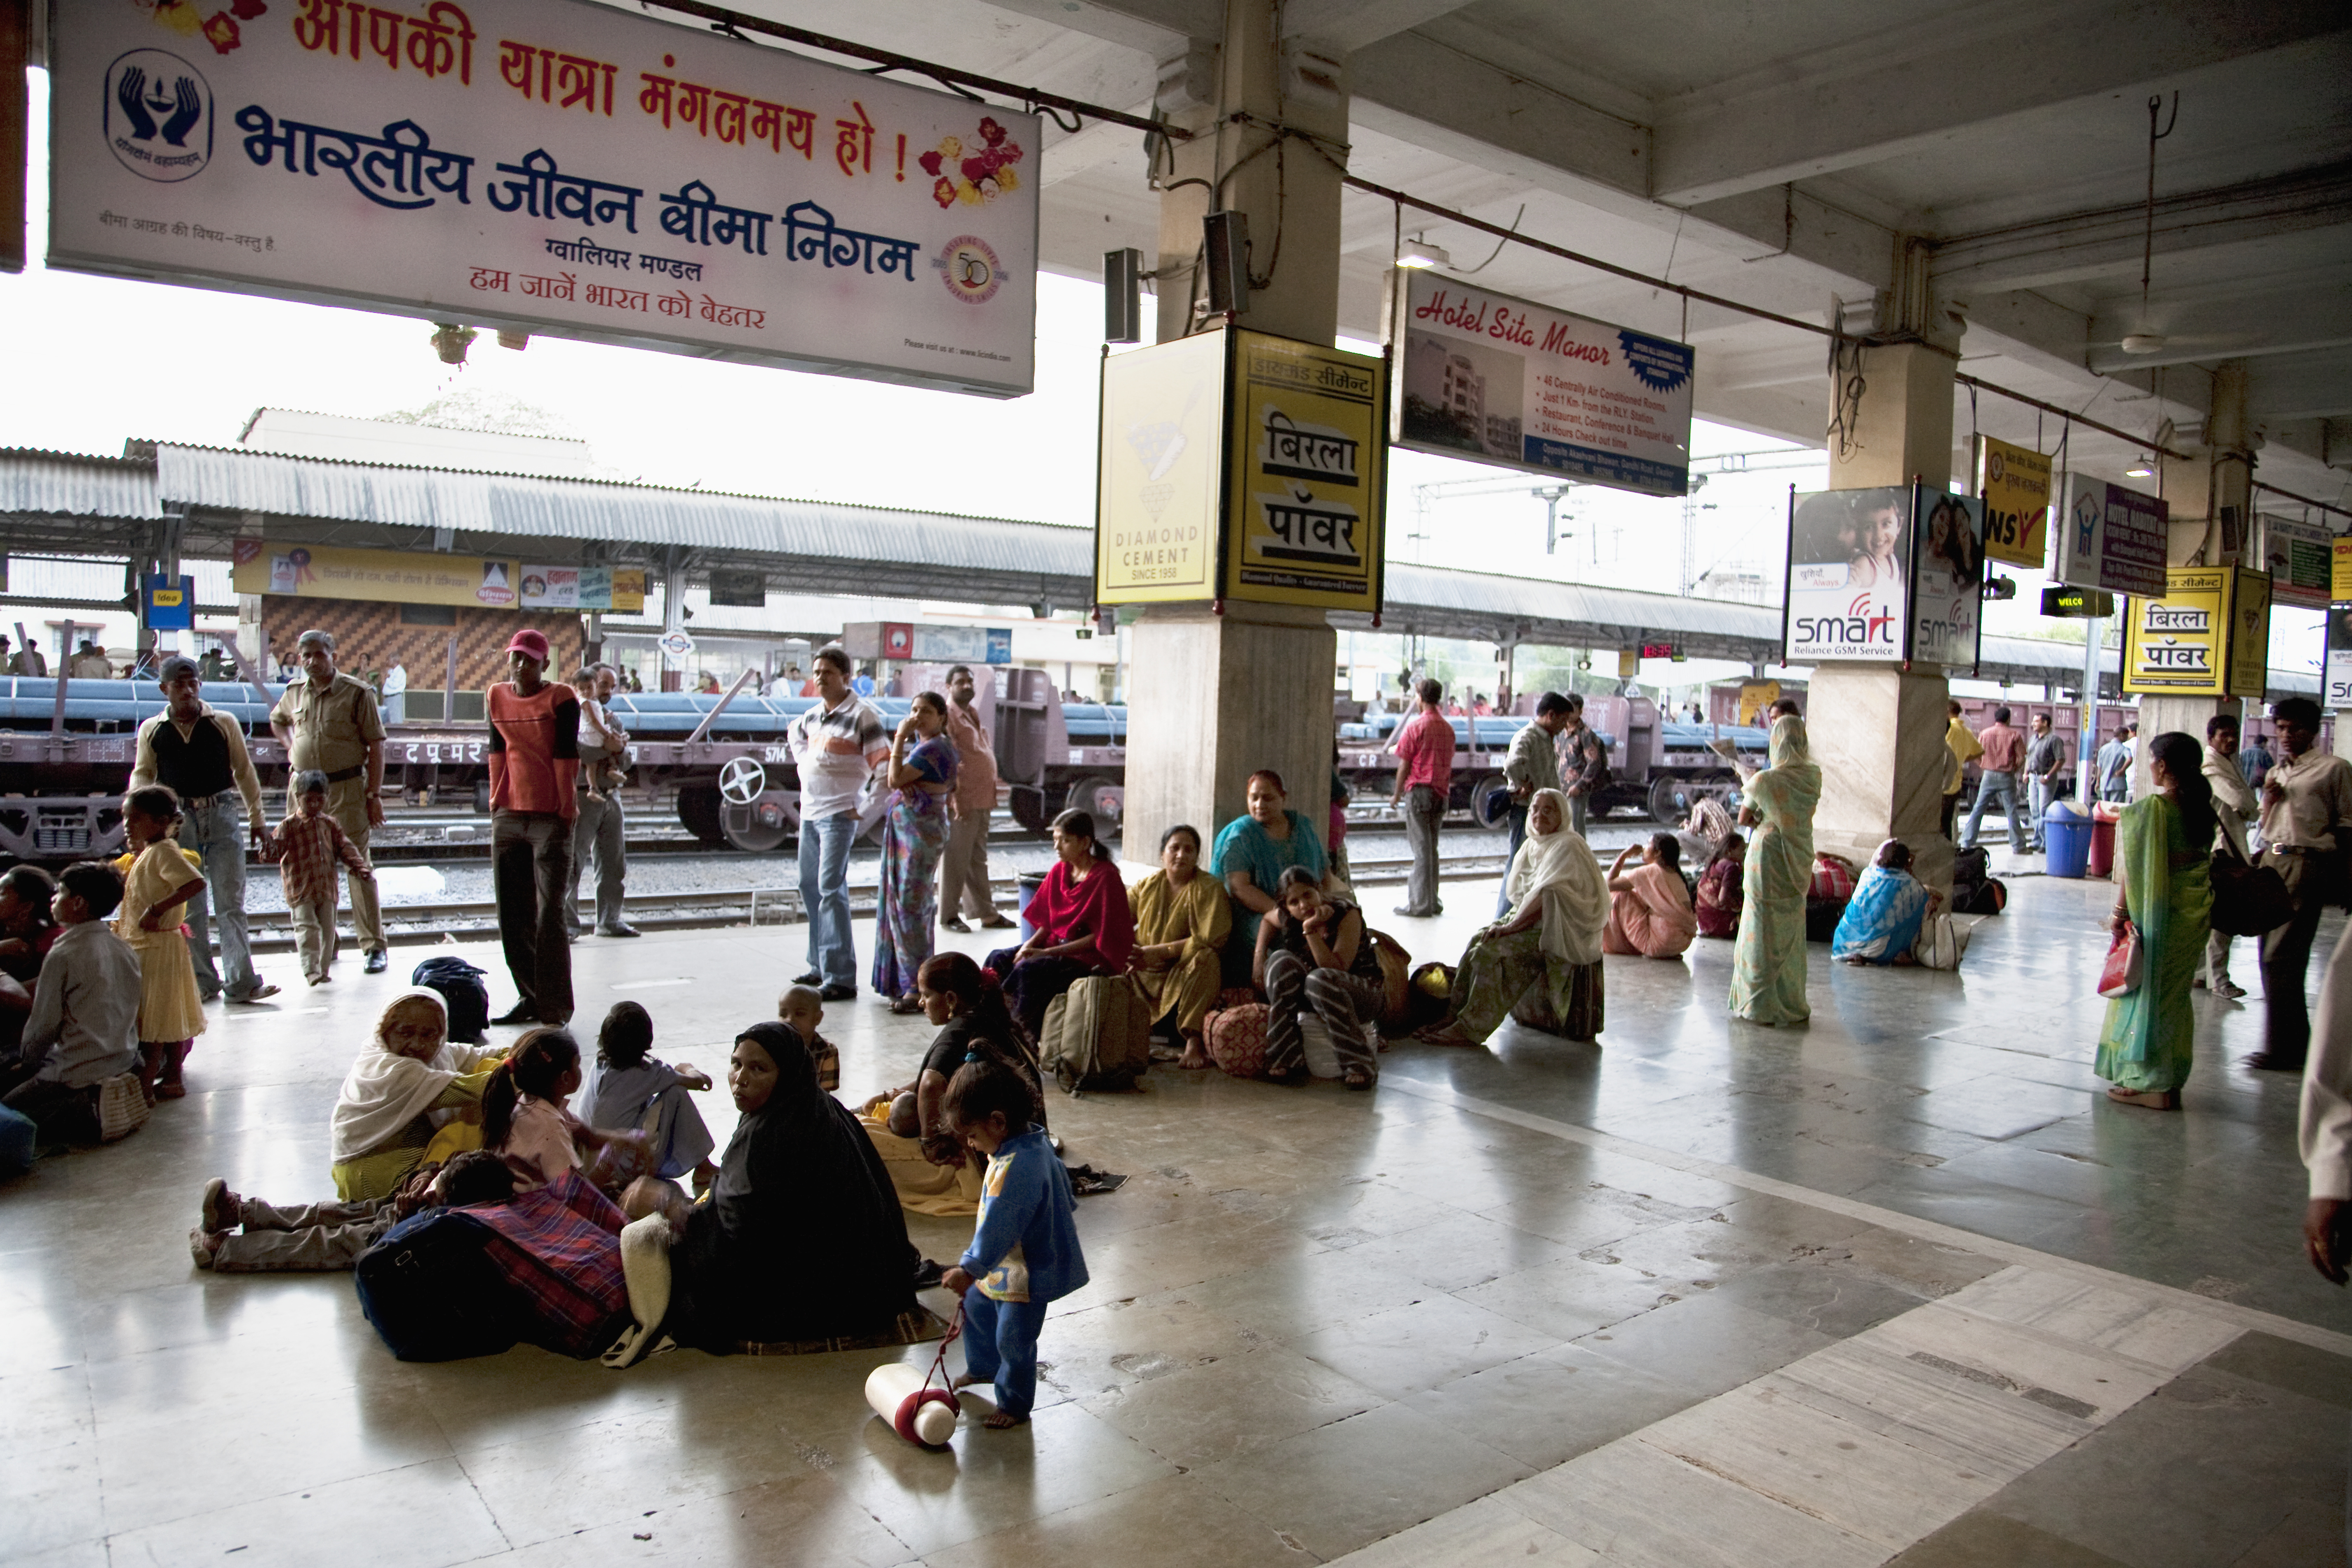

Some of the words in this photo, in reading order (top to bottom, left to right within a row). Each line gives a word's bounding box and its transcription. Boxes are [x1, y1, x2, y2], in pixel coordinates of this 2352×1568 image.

[293, 0, 475, 87] आपकी
[500, 40, 617, 117] यात्रा
[641, 54, 817, 160] मंगलमय
[836, 102, 874, 176] हो
[895, 134, 907, 183] !
[235, 105, 474, 210] भारतीय
[488, 148, 642, 234] जीवन
[660, 180, 772, 256] बीमा
[782, 200, 921, 282] निगम
[100, 210, 127, 227] बीमा
[132, 219, 167, 234] आग्रह
[172, 221, 188, 237] की
[545, 237, 631, 270] ग्वालियर
[640, 253, 703, 282] मण्डल
[469, 266, 511, 294] हम
[519, 271, 577, 303] जानें
[586, 281, 650, 313] भारत
[658, 290, 692, 320] को
[701, 294, 766, 330] बेहतर
[1416, 290, 1485, 333] Hotel
[1489, 307, 1535, 346] Sita
[1540, 322, 1610, 366] Manor
[1315, 366, 1369, 393] सीमेन्ट
[1554, 377, 1586, 396] Centrally
[1588, 384, 1599, 396] Air
[1600, 388, 1642, 407] Conditioned
[1543, 391, 1559, 404] Just
[1561, 394, 1565, 405] 1
[1582, 399, 1599, 412] from
[1600, 404, 1612, 414] the
[1265, 411, 1359, 473] बिरला
[1552, 424, 1573, 438] Hours
[1575, 429, 1597, 443] Check
[1598, 436, 1610, 446] out
[1585, 415, 1625, 434] Conference
[1627, 424, 1632, 435] &
[1634, 425, 1661, 442] Banquet
[1265, 490, 1360, 553] पॉवर
[1116, 526, 1198, 548] DIAMOND
[1123, 548, 1188, 567] CEMENT
[1131, 568, 1156, 581] SINCE
[1158, 567, 1177, 579] 1958
[1795, 605, 1895, 643] smart
[1919, 612, 1973, 646] smart
[2146, 604, 2210, 628] बिरला
[1795, 646, 1832, 656] Reliance
[1835, 646, 1856, 656] GSM
[1860, 646, 1894, 657] Service
[2145, 639, 2210, 667] पॉवर
[765, 747, 786, 763] 5714
